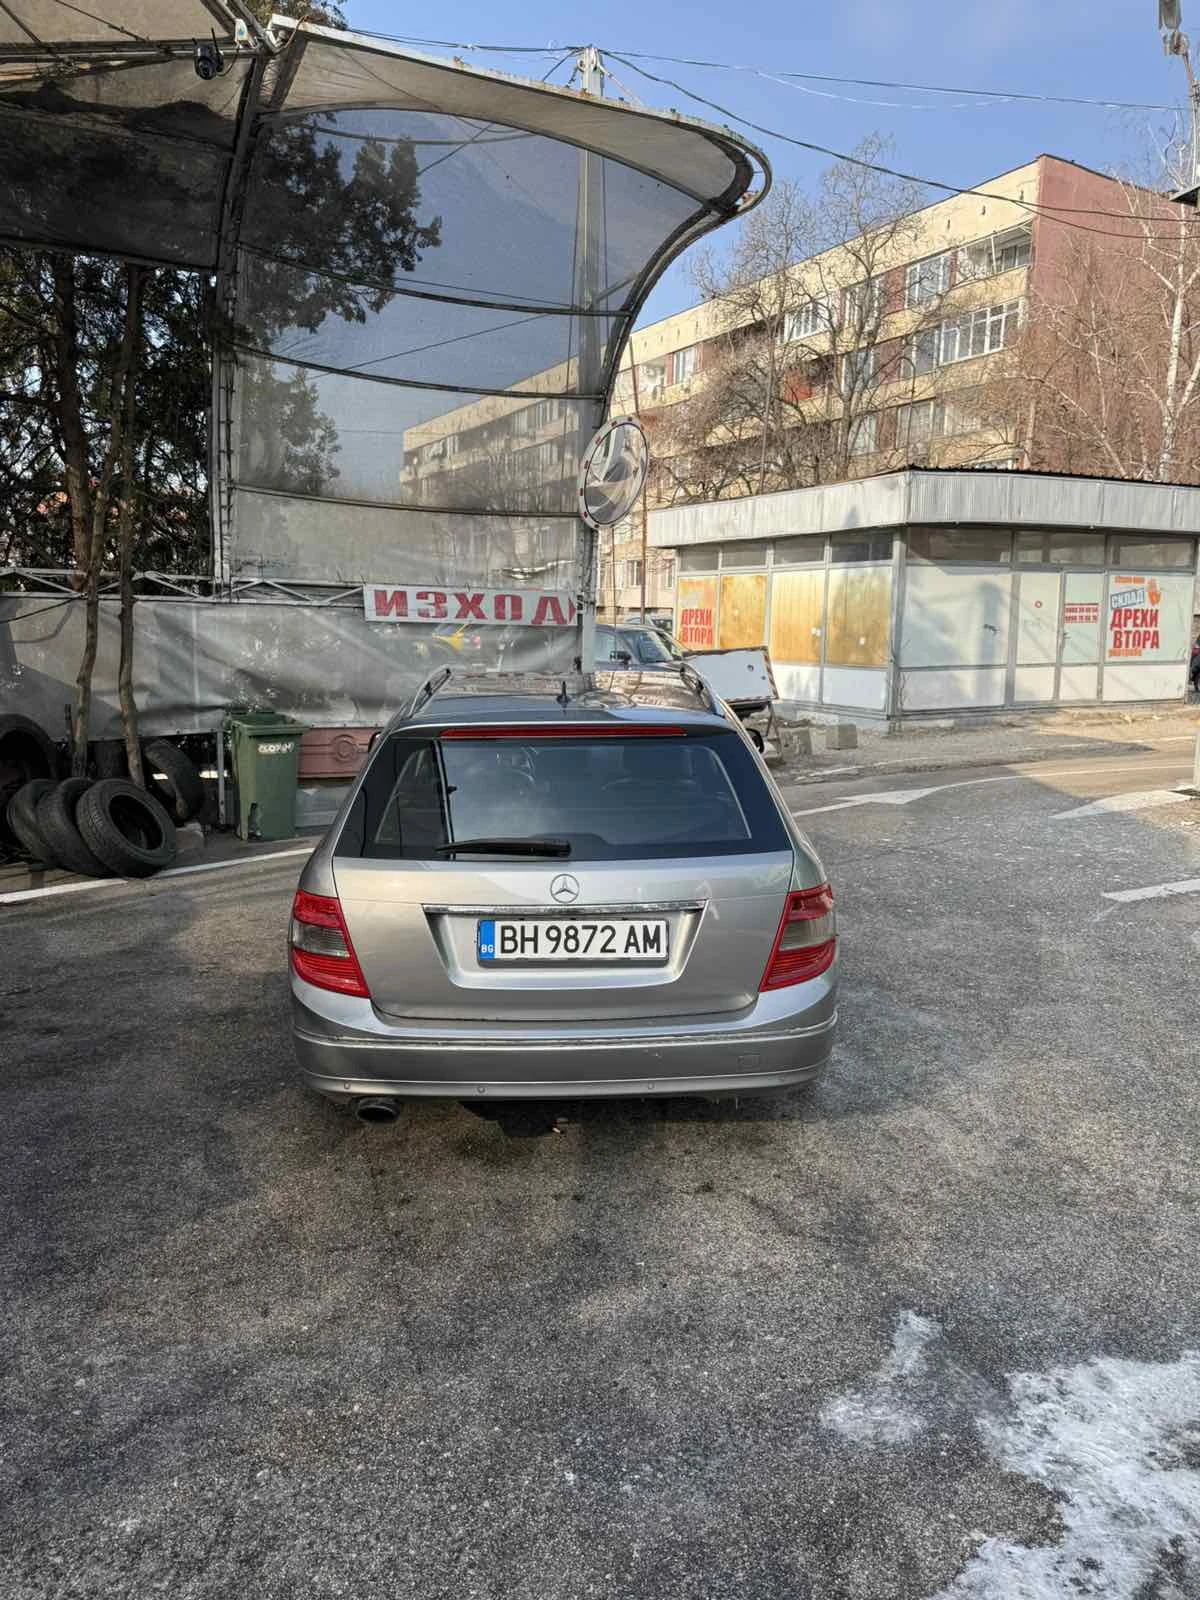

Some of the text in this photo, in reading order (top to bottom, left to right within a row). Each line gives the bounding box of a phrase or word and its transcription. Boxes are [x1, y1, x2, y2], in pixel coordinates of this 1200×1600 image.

[373, 589, 568, 625] ИЗХОД
[680, 608, 712, 628] ДРЕХИ
[1110, 608, 1159, 630] ДРЕХИ
[1113, 629, 1160, 649] ВТОРА
[481, 944, 494, 953] BG
[500, 925, 661, 954] BH 9872 AM
